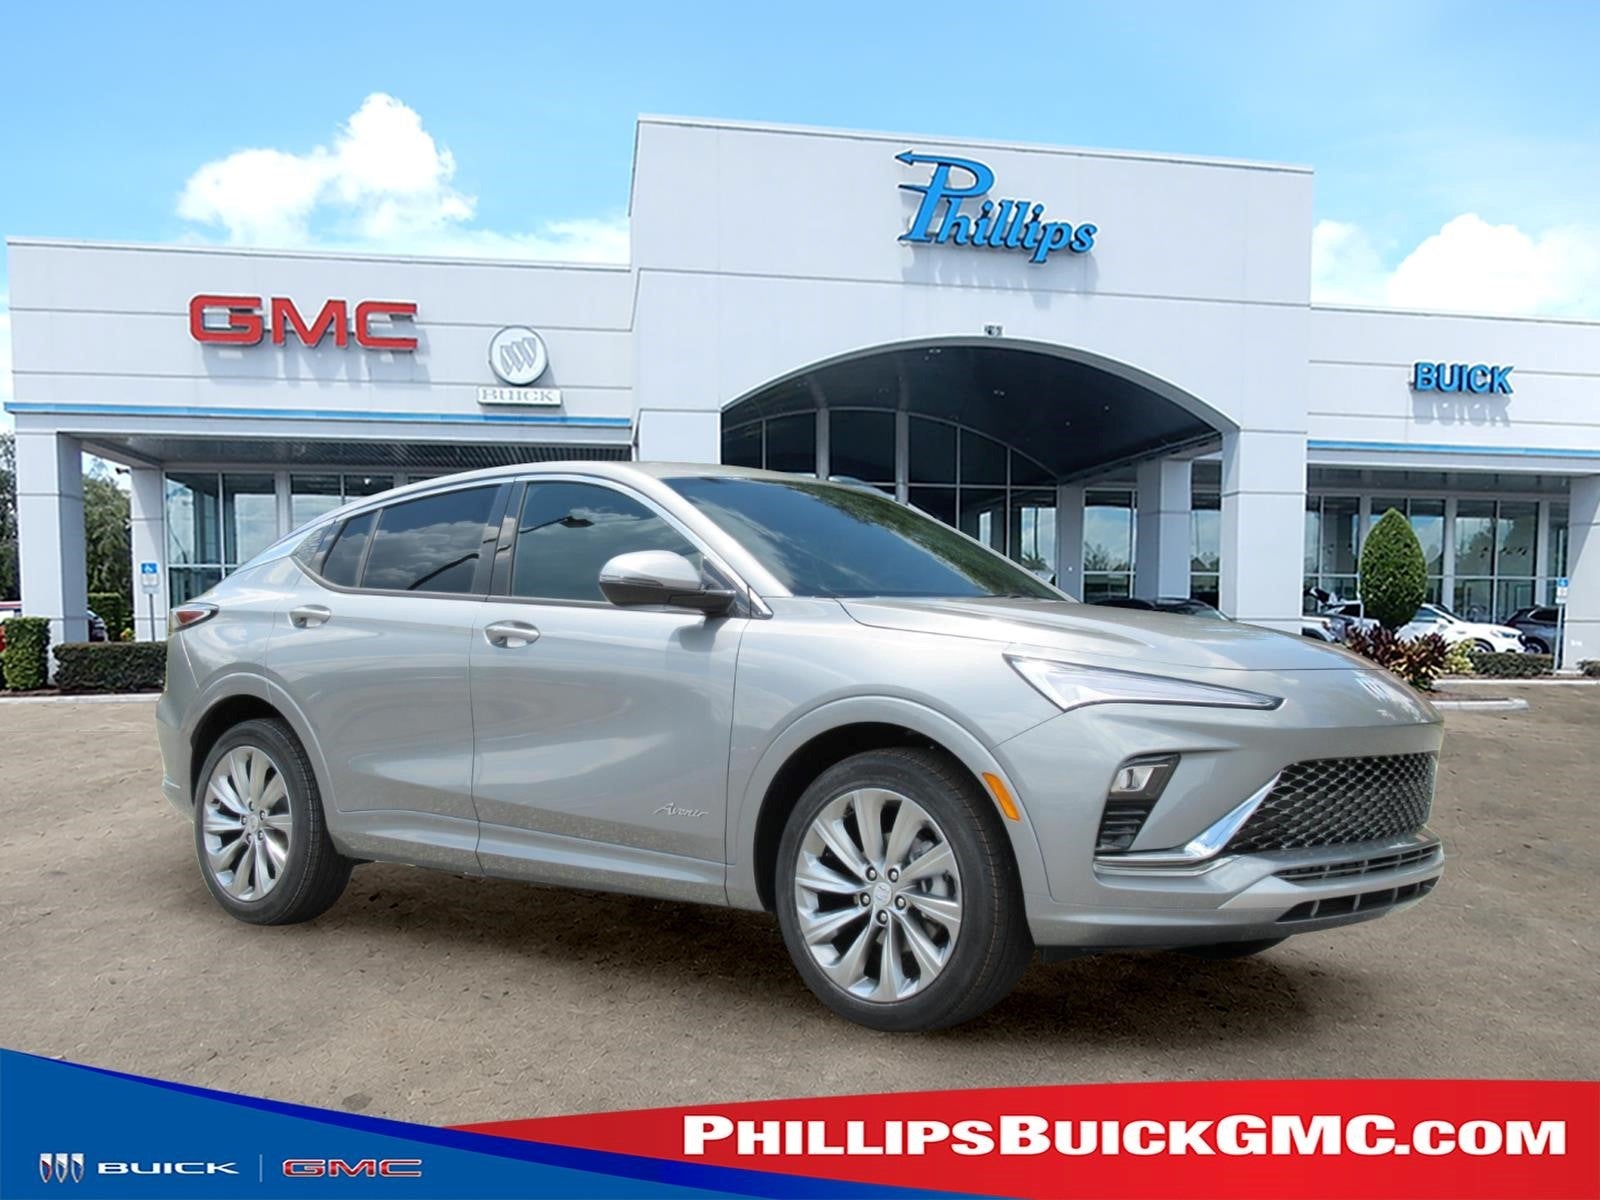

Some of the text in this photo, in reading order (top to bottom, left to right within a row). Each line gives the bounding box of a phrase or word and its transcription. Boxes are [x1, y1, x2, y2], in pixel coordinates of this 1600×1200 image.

[895, 150, 1098, 264] Phillips
[189, 294, 418, 350] GMC
[482, 389, 554, 402] BUICK
[1414, 361, 1514, 394] BUICK
